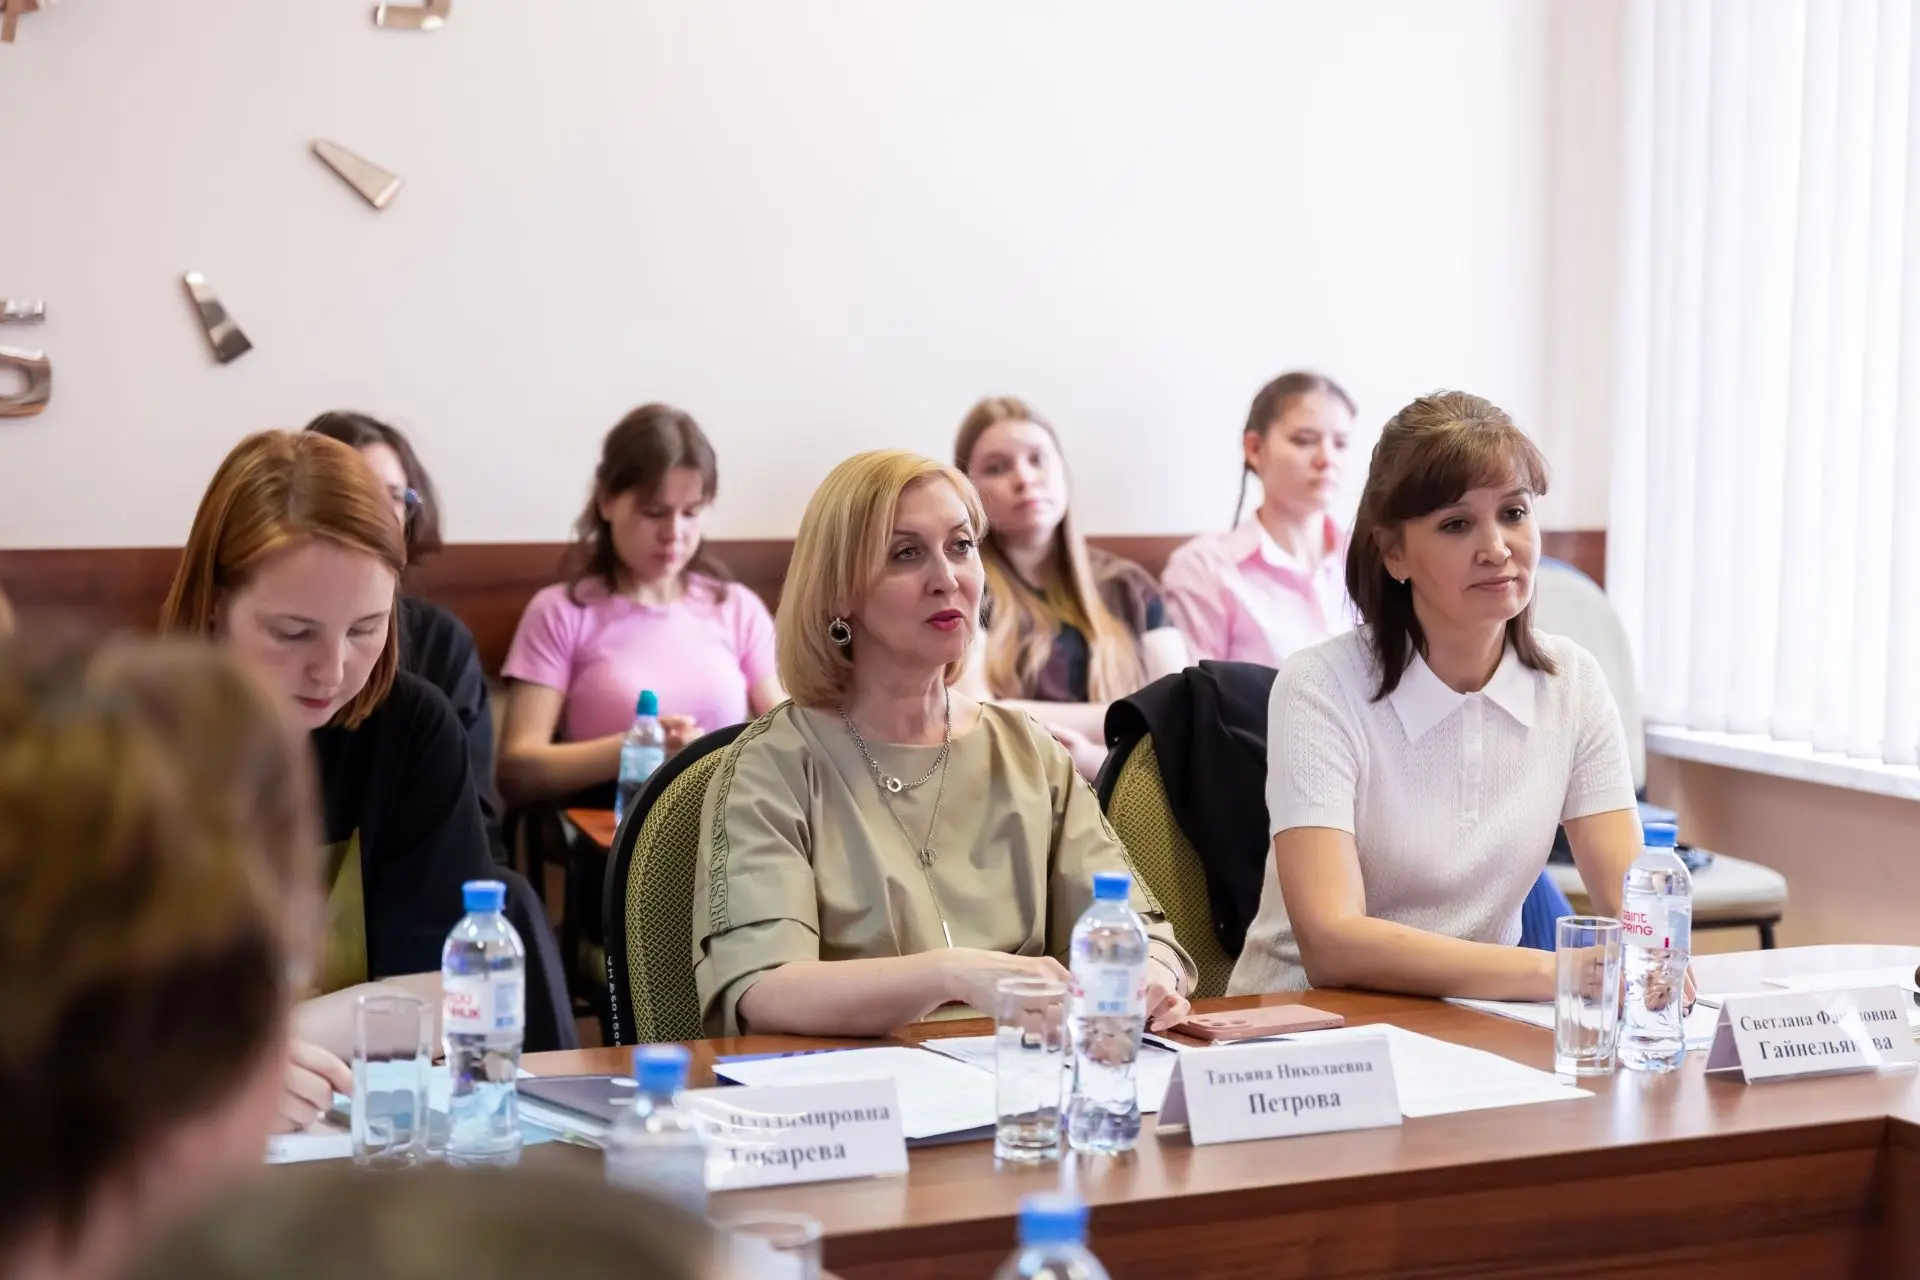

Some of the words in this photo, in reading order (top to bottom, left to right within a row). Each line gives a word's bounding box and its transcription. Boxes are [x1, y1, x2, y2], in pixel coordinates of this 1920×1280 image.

[1740, 1013, 1814, 1032] Светлана
[1758, 1035, 1894, 1060] Гайнельянва
[1205, 1067, 1273, 1086] Татьяна
[1277, 1060, 1373, 1080] Николаевна
[1249, 1091, 1341, 1117] Петрова
